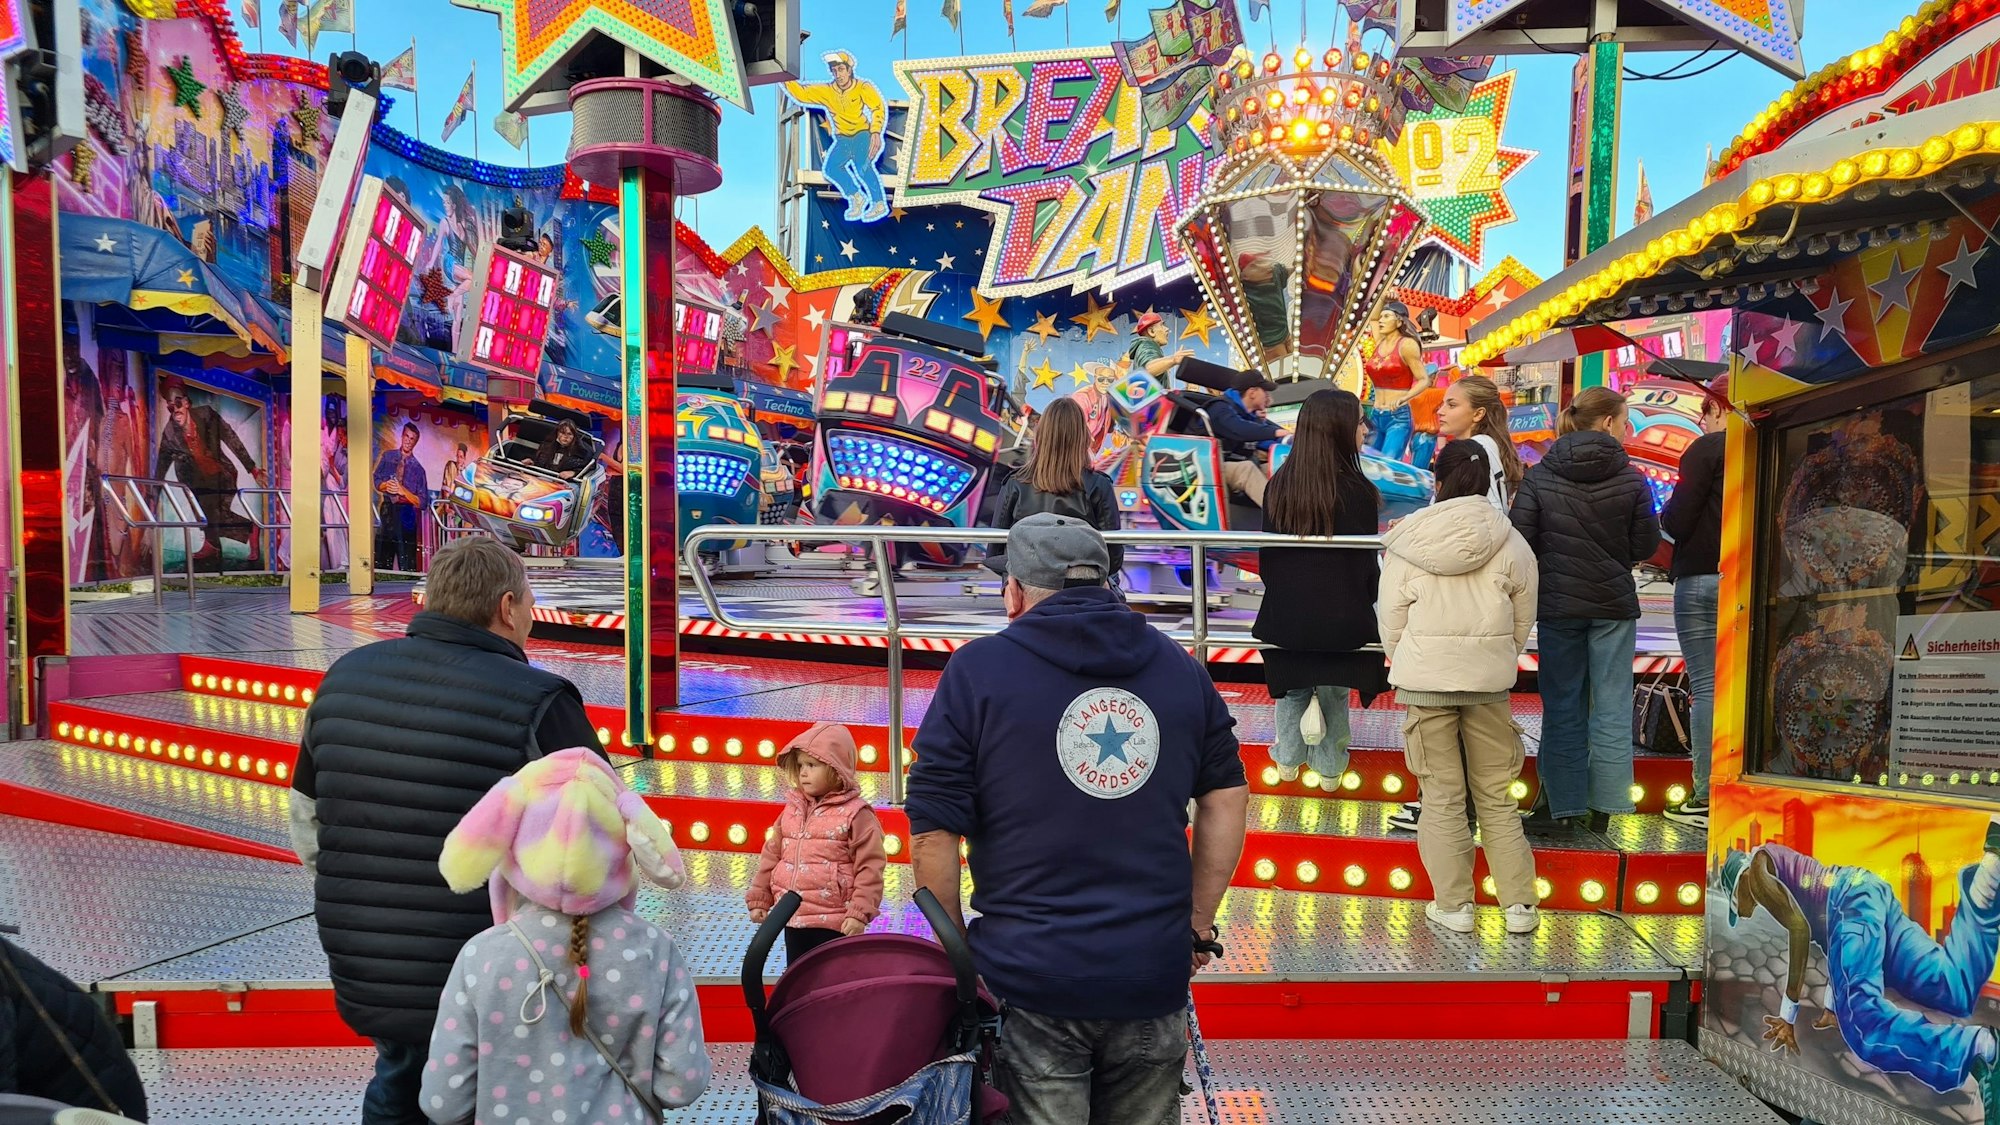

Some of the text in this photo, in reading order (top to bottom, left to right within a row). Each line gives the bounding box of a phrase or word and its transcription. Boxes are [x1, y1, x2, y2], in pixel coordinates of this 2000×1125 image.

[1451, 115, 1502, 195] 2
[904, 356, 942, 382] 22
[1127, 380, 1146, 400] 6
[1648, 389, 1677, 406] 19
[764, 399, 805, 416] Techno
[1073, 699, 1144, 731] LANGEOOG
[1076, 757, 1147, 789] NORDSEE
